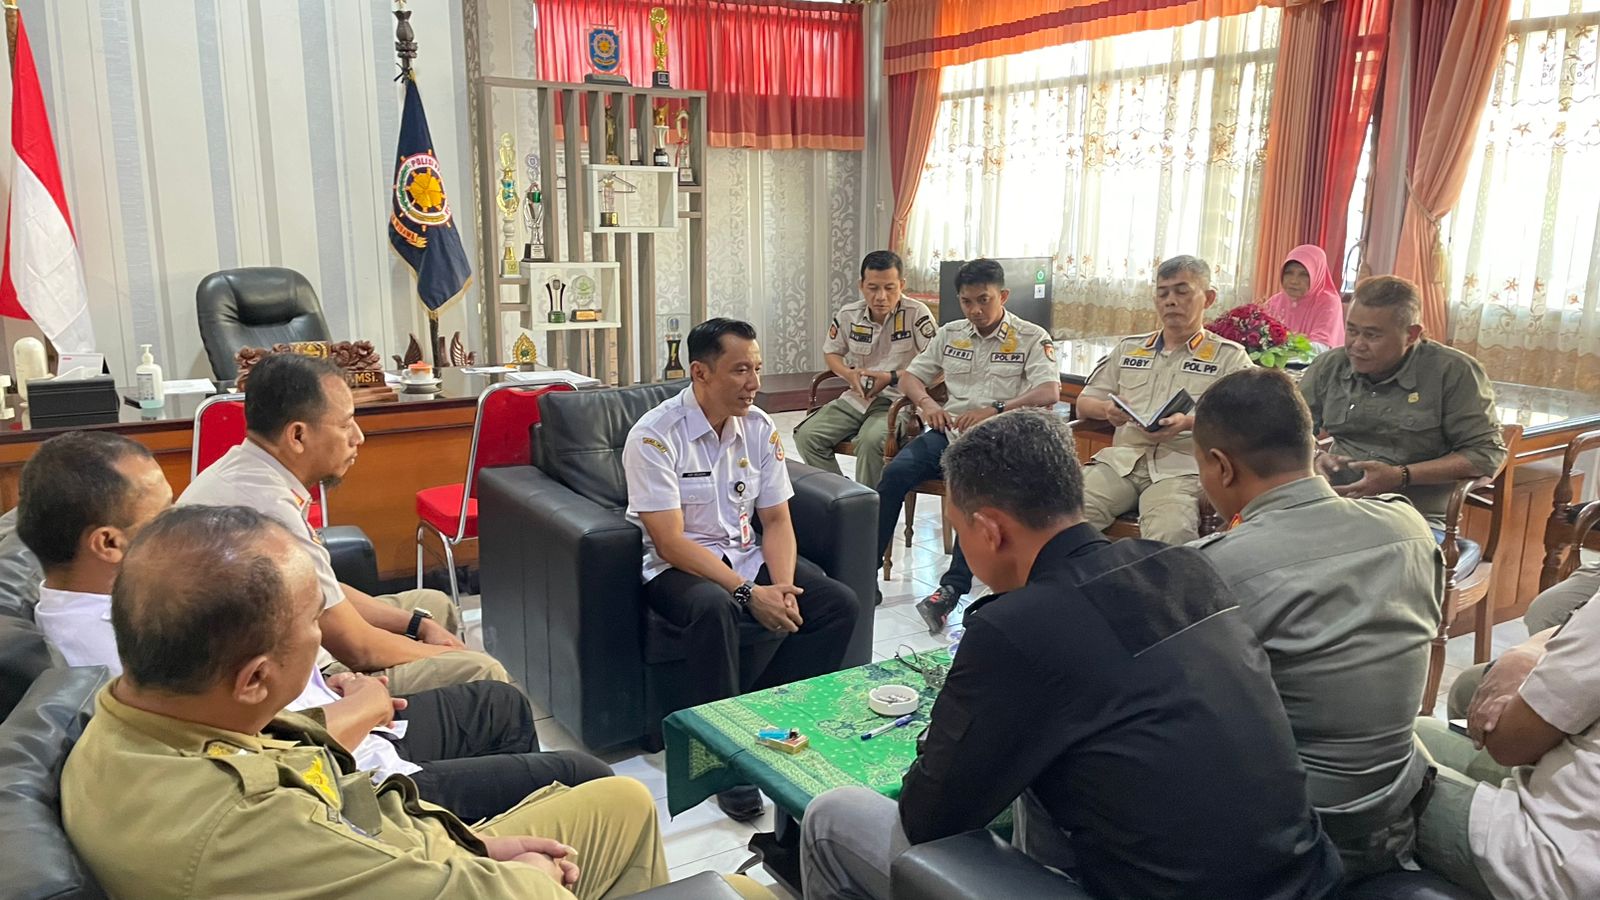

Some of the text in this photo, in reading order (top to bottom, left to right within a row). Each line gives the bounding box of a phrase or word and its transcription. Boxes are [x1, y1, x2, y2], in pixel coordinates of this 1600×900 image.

[1123, 357, 1150, 367] ROBY
[1183, 361, 1218, 374] POL PP
